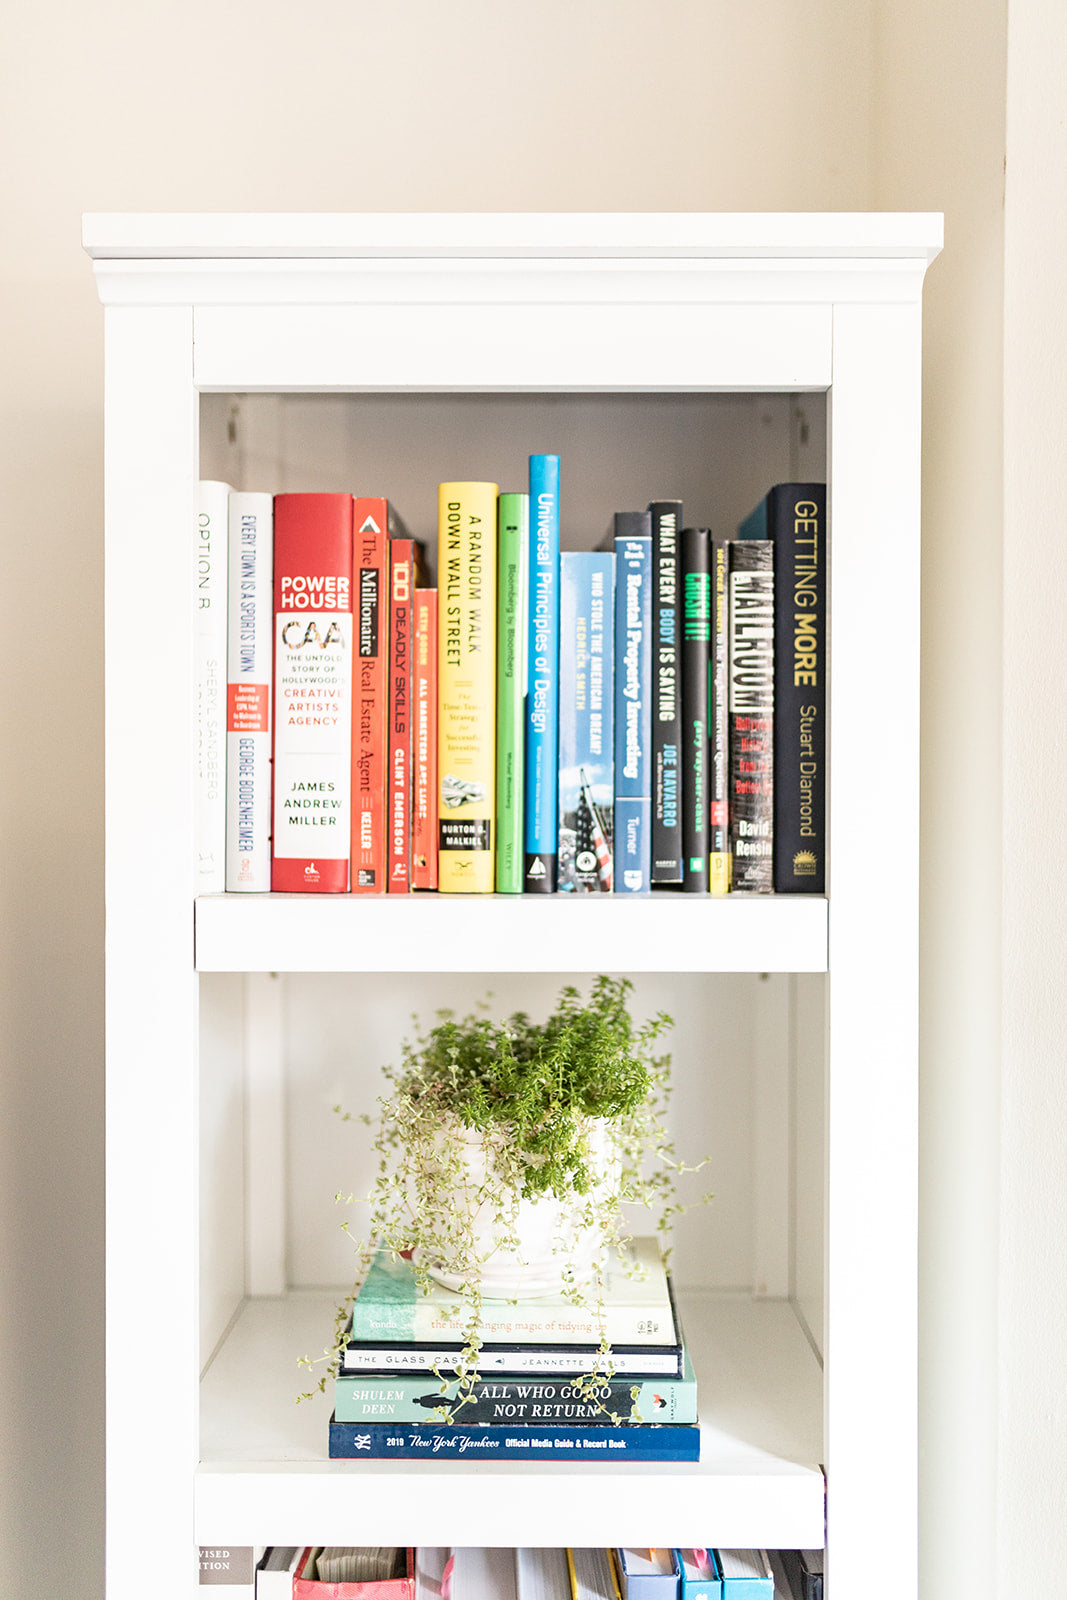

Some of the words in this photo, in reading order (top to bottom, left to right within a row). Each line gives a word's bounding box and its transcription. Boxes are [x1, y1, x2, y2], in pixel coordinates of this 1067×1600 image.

[241, 515, 256, 545] EVERY
[448, 502, 460, 549] DOWN
[469, 516, 481, 524] A
[536, 494, 554, 565] Universal
[659, 513, 676, 554] WHAT
[198, 513, 211, 589] OPTION
[241, 550, 256, 578] TOWN
[362, 536, 376, 565] The
[468, 531, 481, 600] RANDOM
[794, 501, 818, 607] GETTING
[241, 581, 256, 590] IS
[281, 576, 350, 592] POWER
[393, 560, 409, 601] 100
[448, 557, 460, 601] WALL
[505, 564, 516, 614] Bloomberg
[591, 572, 604, 597] WHO
[659, 558, 676, 605] EVERY
[684, 573, 710, 619] CRUSH
[281, 593, 349, 609] HOUSE
[361, 570, 377, 656] Millionaire
[419, 606, 428, 633] SETH
[506, 616, 514, 624] by
[532, 572, 553, 652] Principles
[591, 600, 604, 629] STOLE
[626, 574, 642, 628] Rental
[240, 602, 256, 641] SPORTS
[282, 621, 345, 649] CAA
[395, 607, 406, 672] DEADLY
[447, 607, 460, 667] STREET
[468, 609, 481, 653] WALK
[659, 608, 675, 645] BODY
[684, 622, 710, 641] IT!
[240, 644, 255, 672] TOWN
[419, 634, 428, 665] GODIN
[505, 628, 515, 678] Bloomberg
[576, 617, 586, 668] HEDRICK
[591, 632, 603, 653] THE
[659, 648, 675, 663] IS
[794, 614, 817, 686] MORE
[361, 661, 375, 692] Real
[534, 657, 549, 673] of
[590, 657, 603, 710] AMERICAN
[623, 630, 642, 700] Property
[395, 676, 406, 733] SKILLS
[419, 678, 428, 698] ALL
[530, 679, 550, 733] Design
[576, 673, 586, 710] SMITH
[659, 667, 675, 721] SAYING
[288, 703, 338, 712] ARTISTS
[288, 717, 338, 725] AGENCY
[360, 699, 375, 743] Estate
[419, 701, 428, 762] MARKETERS
[589, 713, 602, 755] DREAM?
[623, 701, 642, 779] Investing
[800, 705, 817, 758] Stuart
[239, 738, 254, 777] GEORGE
[357, 750, 375, 792] Agent
[394, 748, 404, 787] CLINT
[663, 744, 677, 766] JOE
[284, 799, 342, 809] ANDREW
[291, 782, 335, 792] JAMES
[663, 769, 677, 827] NAVARRO
[800, 762, 817, 837] Diamond
[238, 780, 254, 852] BODENHEIMER
[289, 816, 337, 825] MILLER
[361, 811, 372, 849] KELLER
[393, 792, 404, 855] EMERSON
[442, 825, 475, 834] BURTON
[739, 820, 769, 836] David
[446, 837, 482, 846] MALKIEL
[626, 817, 640, 855] Turner
[736, 840, 773, 856] Rensin
[370, 1319, 397, 1329] kondo
[431, 1319, 446, 1329] the
[514, 1321, 542, 1333] magic
[545, 1320, 556, 1330] of
[558, 1321, 591, 1333] tidying
[352, 1390, 405, 1400] SHULEM
[362, 1404, 395, 1414] DEEN
[479, 1386, 512, 1398] ALL
[516, 1386, 556, 1399] WHO
[560, 1386, 583, 1399] GO
[591, 1386, 612, 1399] DO
[493, 1404, 527, 1416] NOT
[531, 1405, 598, 1417] RETURN
[387, 1438, 404, 1447] 2019
[408, 1435, 433, 1447] New
[432, 1435, 456, 1452] York
[458, 1435, 499, 1452] Yankees
[505, 1438, 529, 1447] Official
[531, 1439, 553, 1448] Media
[554, 1439, 574, 1448] Guide
[575, 1440, 581, 1448] &
[583, 1439, 607, 1448] Record
[609, 1439, 626, 1448] Book
